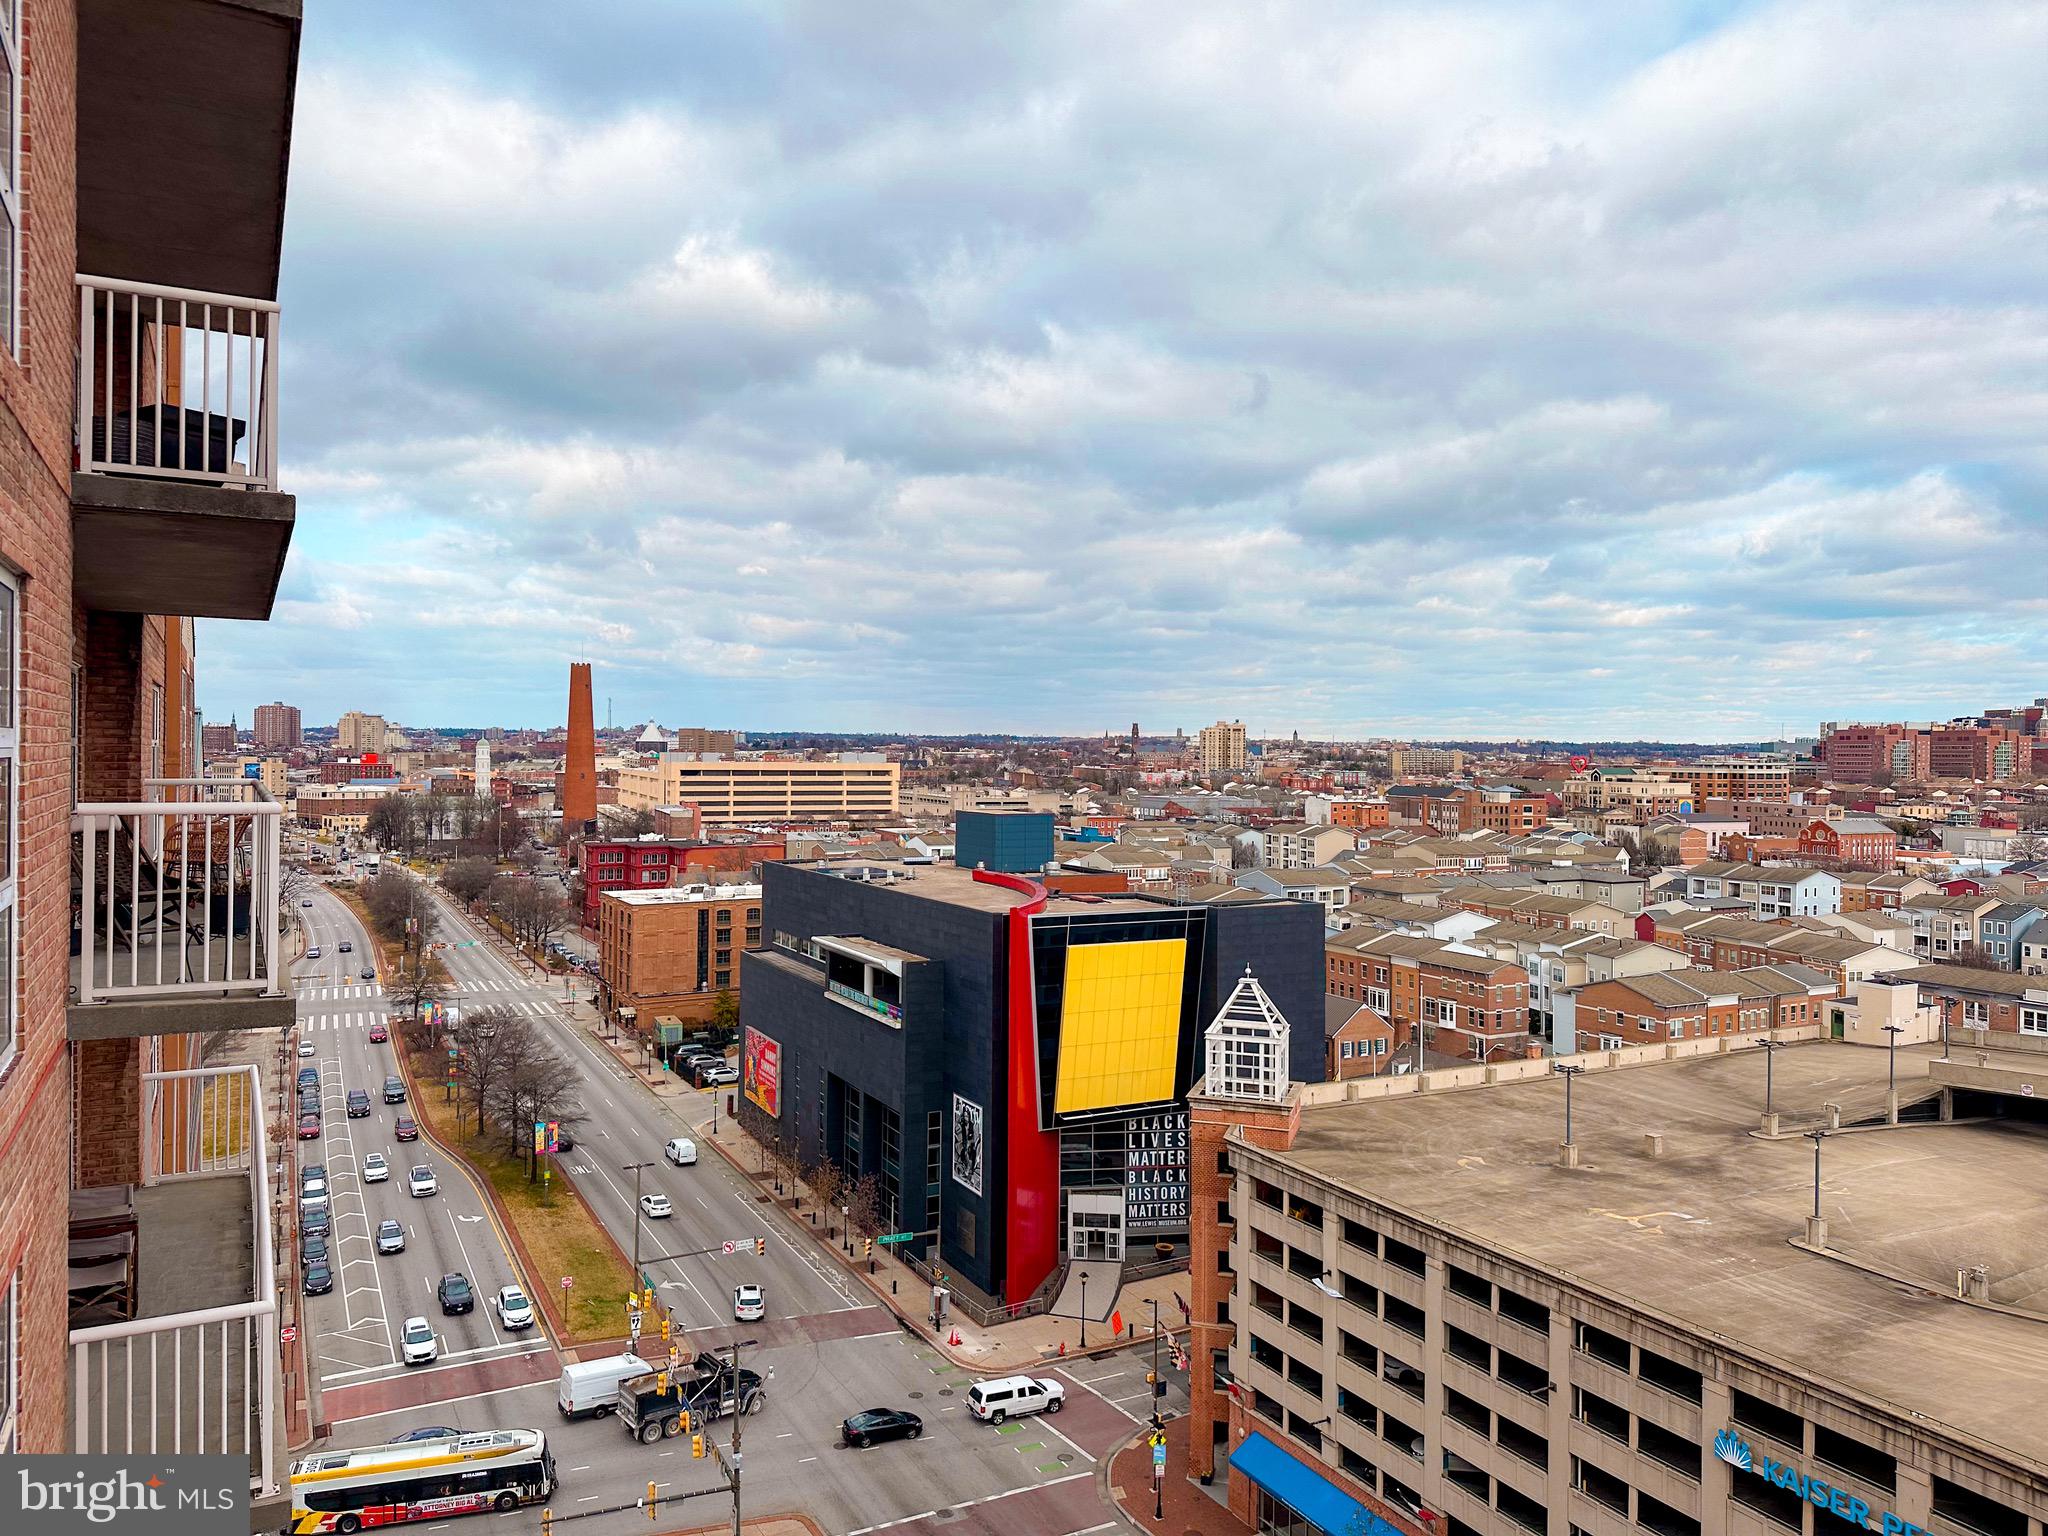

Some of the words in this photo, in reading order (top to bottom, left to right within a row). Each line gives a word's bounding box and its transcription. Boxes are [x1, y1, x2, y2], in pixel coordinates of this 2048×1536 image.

[1128, 1114, 1186, 1131] BLACK
[1128, 1132, 1186, 1148] LIVES
[1128, 1150, 1186, 1167] MATTER
[1128, 1168, 1187, 1184] BLACK
[1128, 1186, 1187, 1201] HISTORY
[1128, 1202, 1186, 1218] MATTERS
[1763, 1455, 1871, 1531] KAISER
[423, 1502, 455, 1511] ATTORNEY
